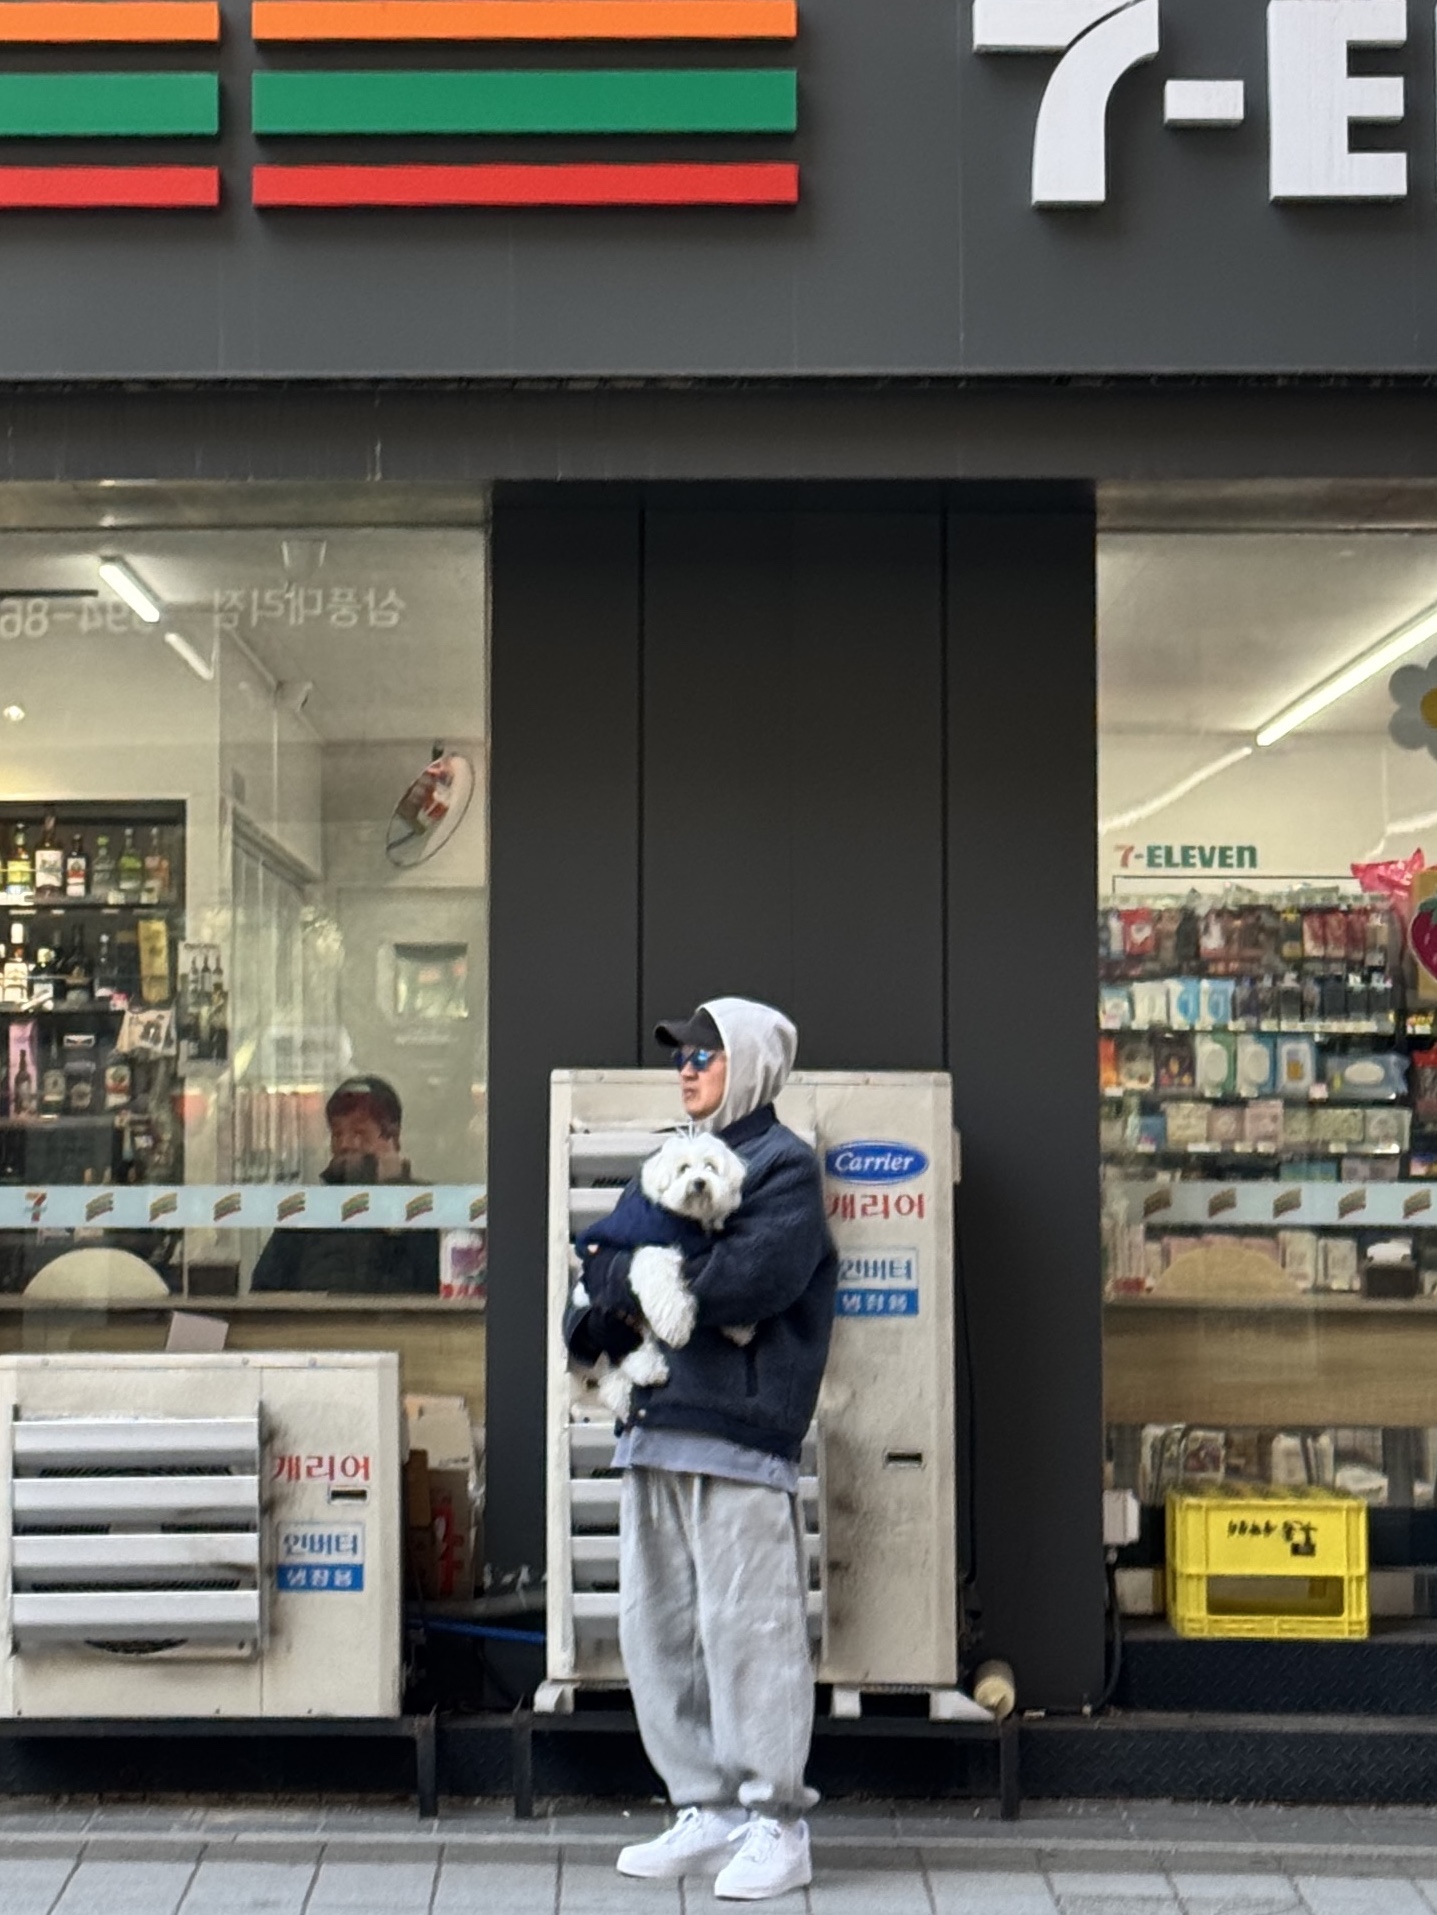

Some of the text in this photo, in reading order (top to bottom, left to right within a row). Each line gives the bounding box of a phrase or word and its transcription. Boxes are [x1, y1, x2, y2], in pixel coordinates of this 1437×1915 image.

[972, 0, 1437, 206] 7-E
[834, 1151, 916, 1172] Carrier
[283, 1532, 358, 1557] 인버터
